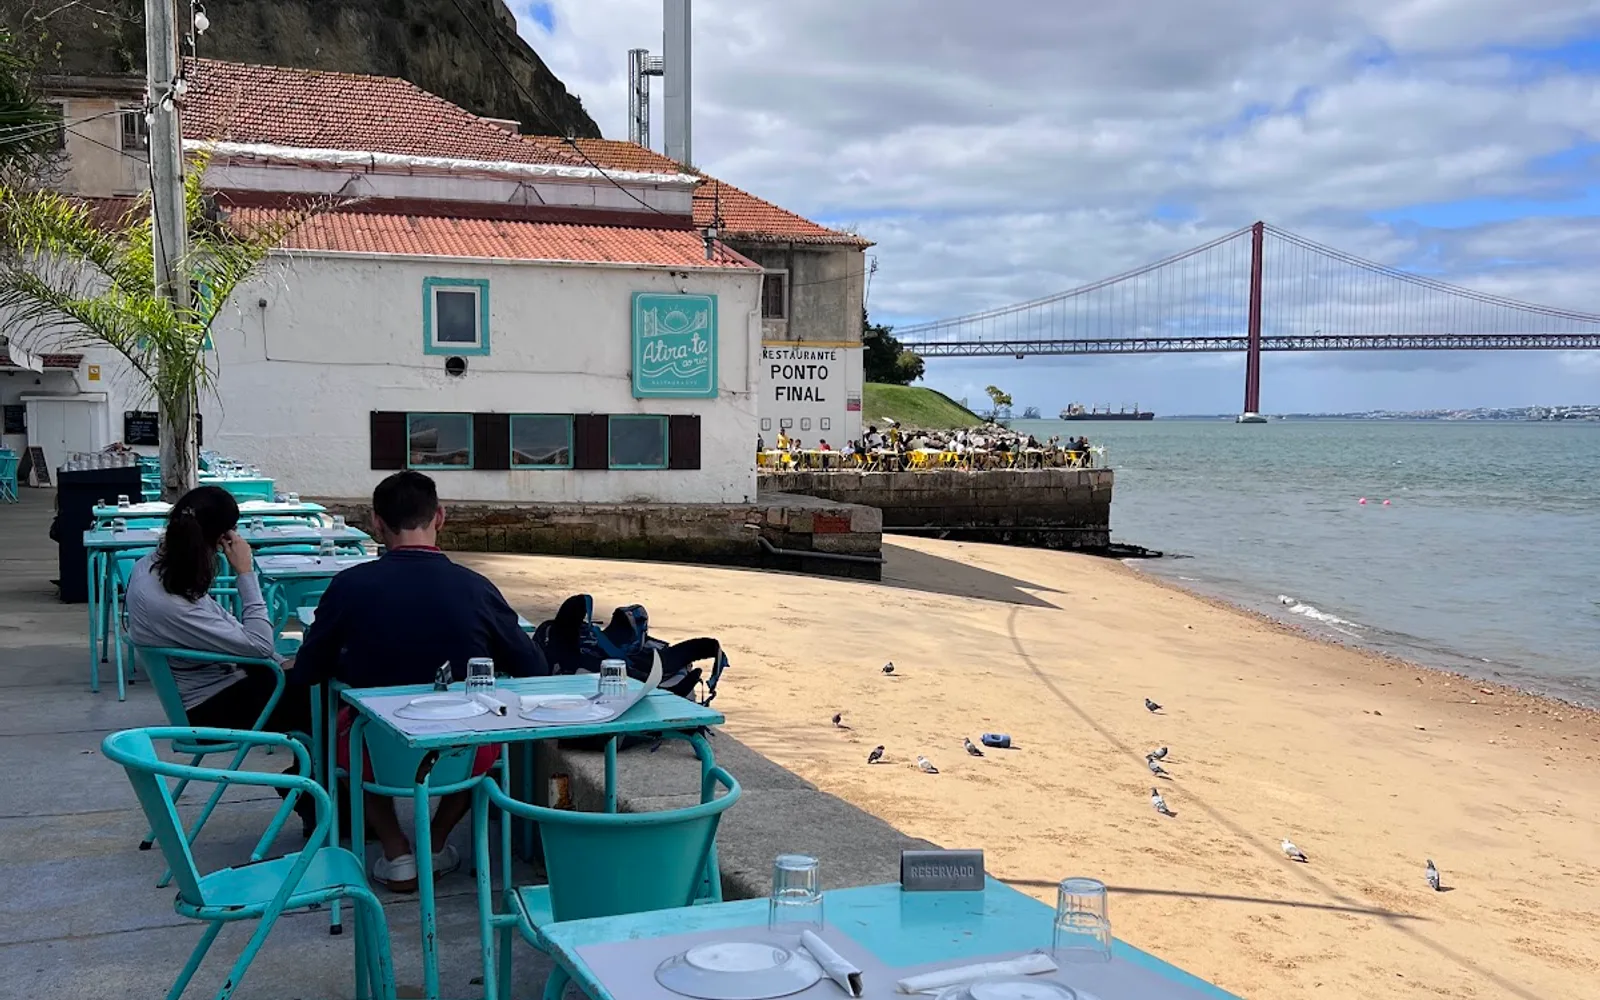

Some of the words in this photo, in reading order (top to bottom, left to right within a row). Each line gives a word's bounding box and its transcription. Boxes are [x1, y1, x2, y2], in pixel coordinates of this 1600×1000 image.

[762, 350, 837, 361] RESTAURANTE
[770, 364, 829, 380] PONTO
[775, 386, 825, 402] FINAL
[911, 865, 975, 878] RESERVADO
